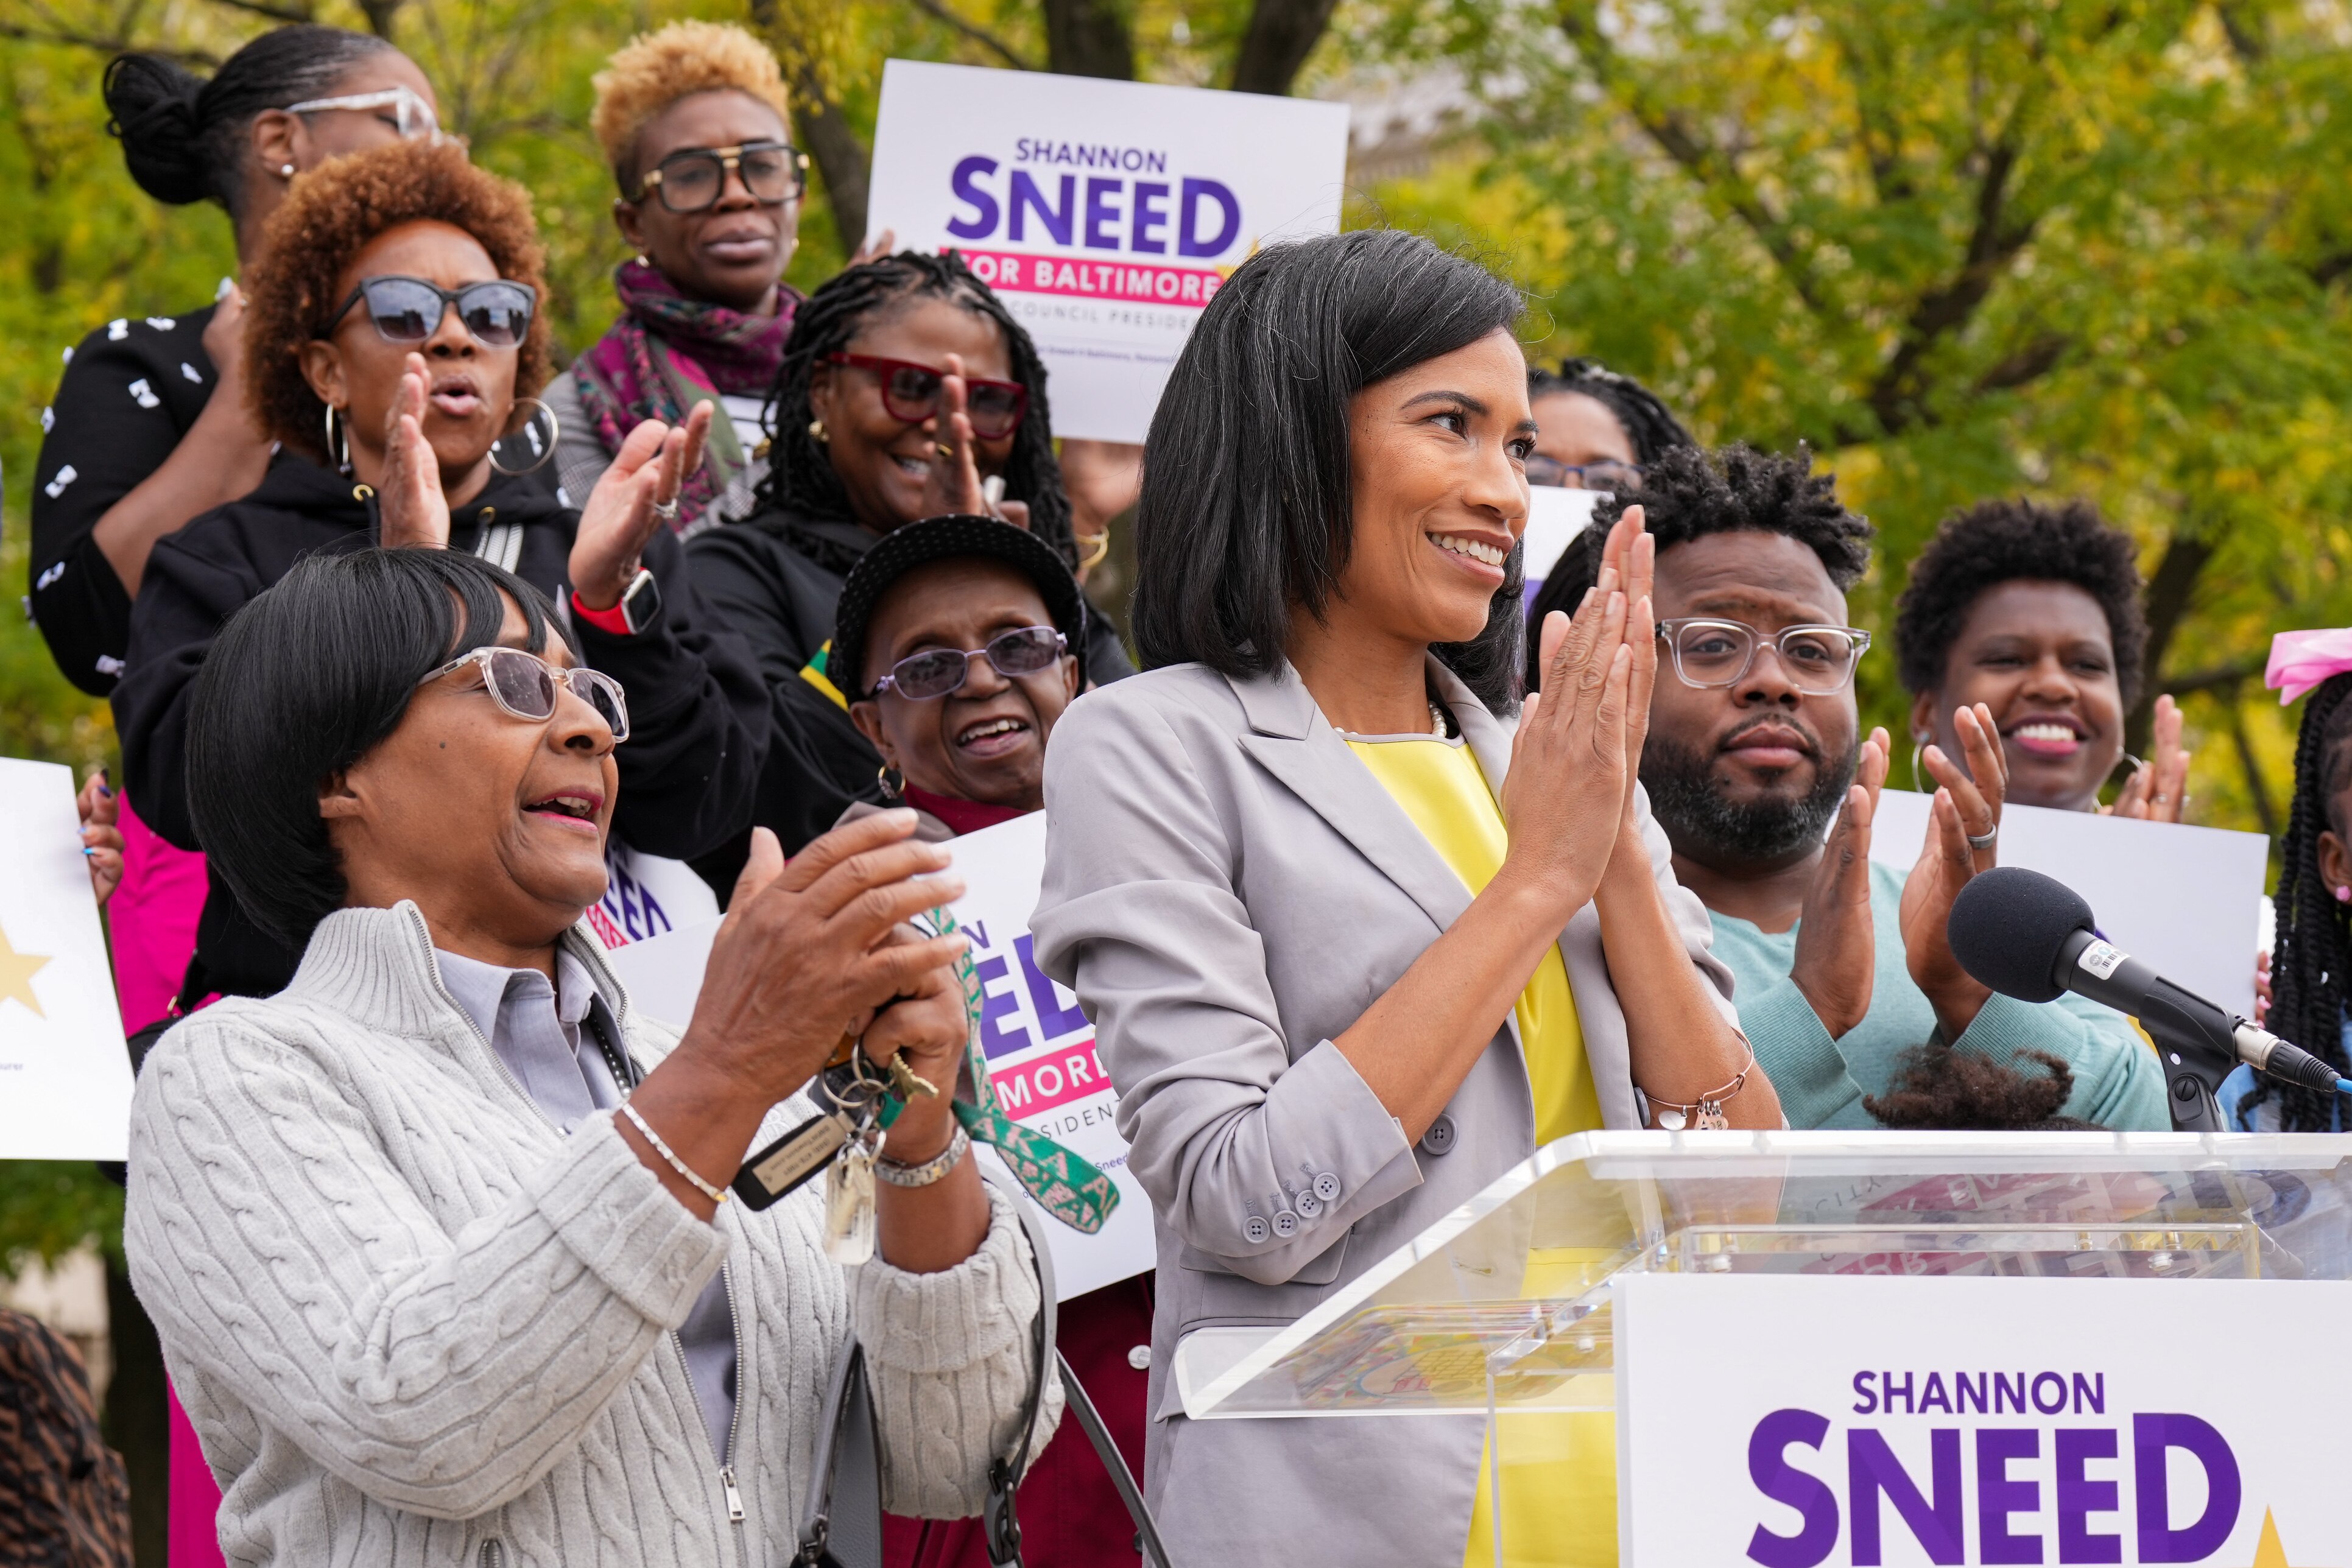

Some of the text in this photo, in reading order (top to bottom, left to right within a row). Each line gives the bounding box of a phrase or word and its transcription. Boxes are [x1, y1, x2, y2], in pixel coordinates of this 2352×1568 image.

[1016, 138, 1167, 174] SHANNON
[946, 155, 1242, 260] SNEED
[960, 254, 1020, 284] OR
[1108, 309, 1191, 332] PRESIDE
[1853, 1370, 2105, 1415] SHANNON
[1746, 1408, 2242, 1568] SNEED
